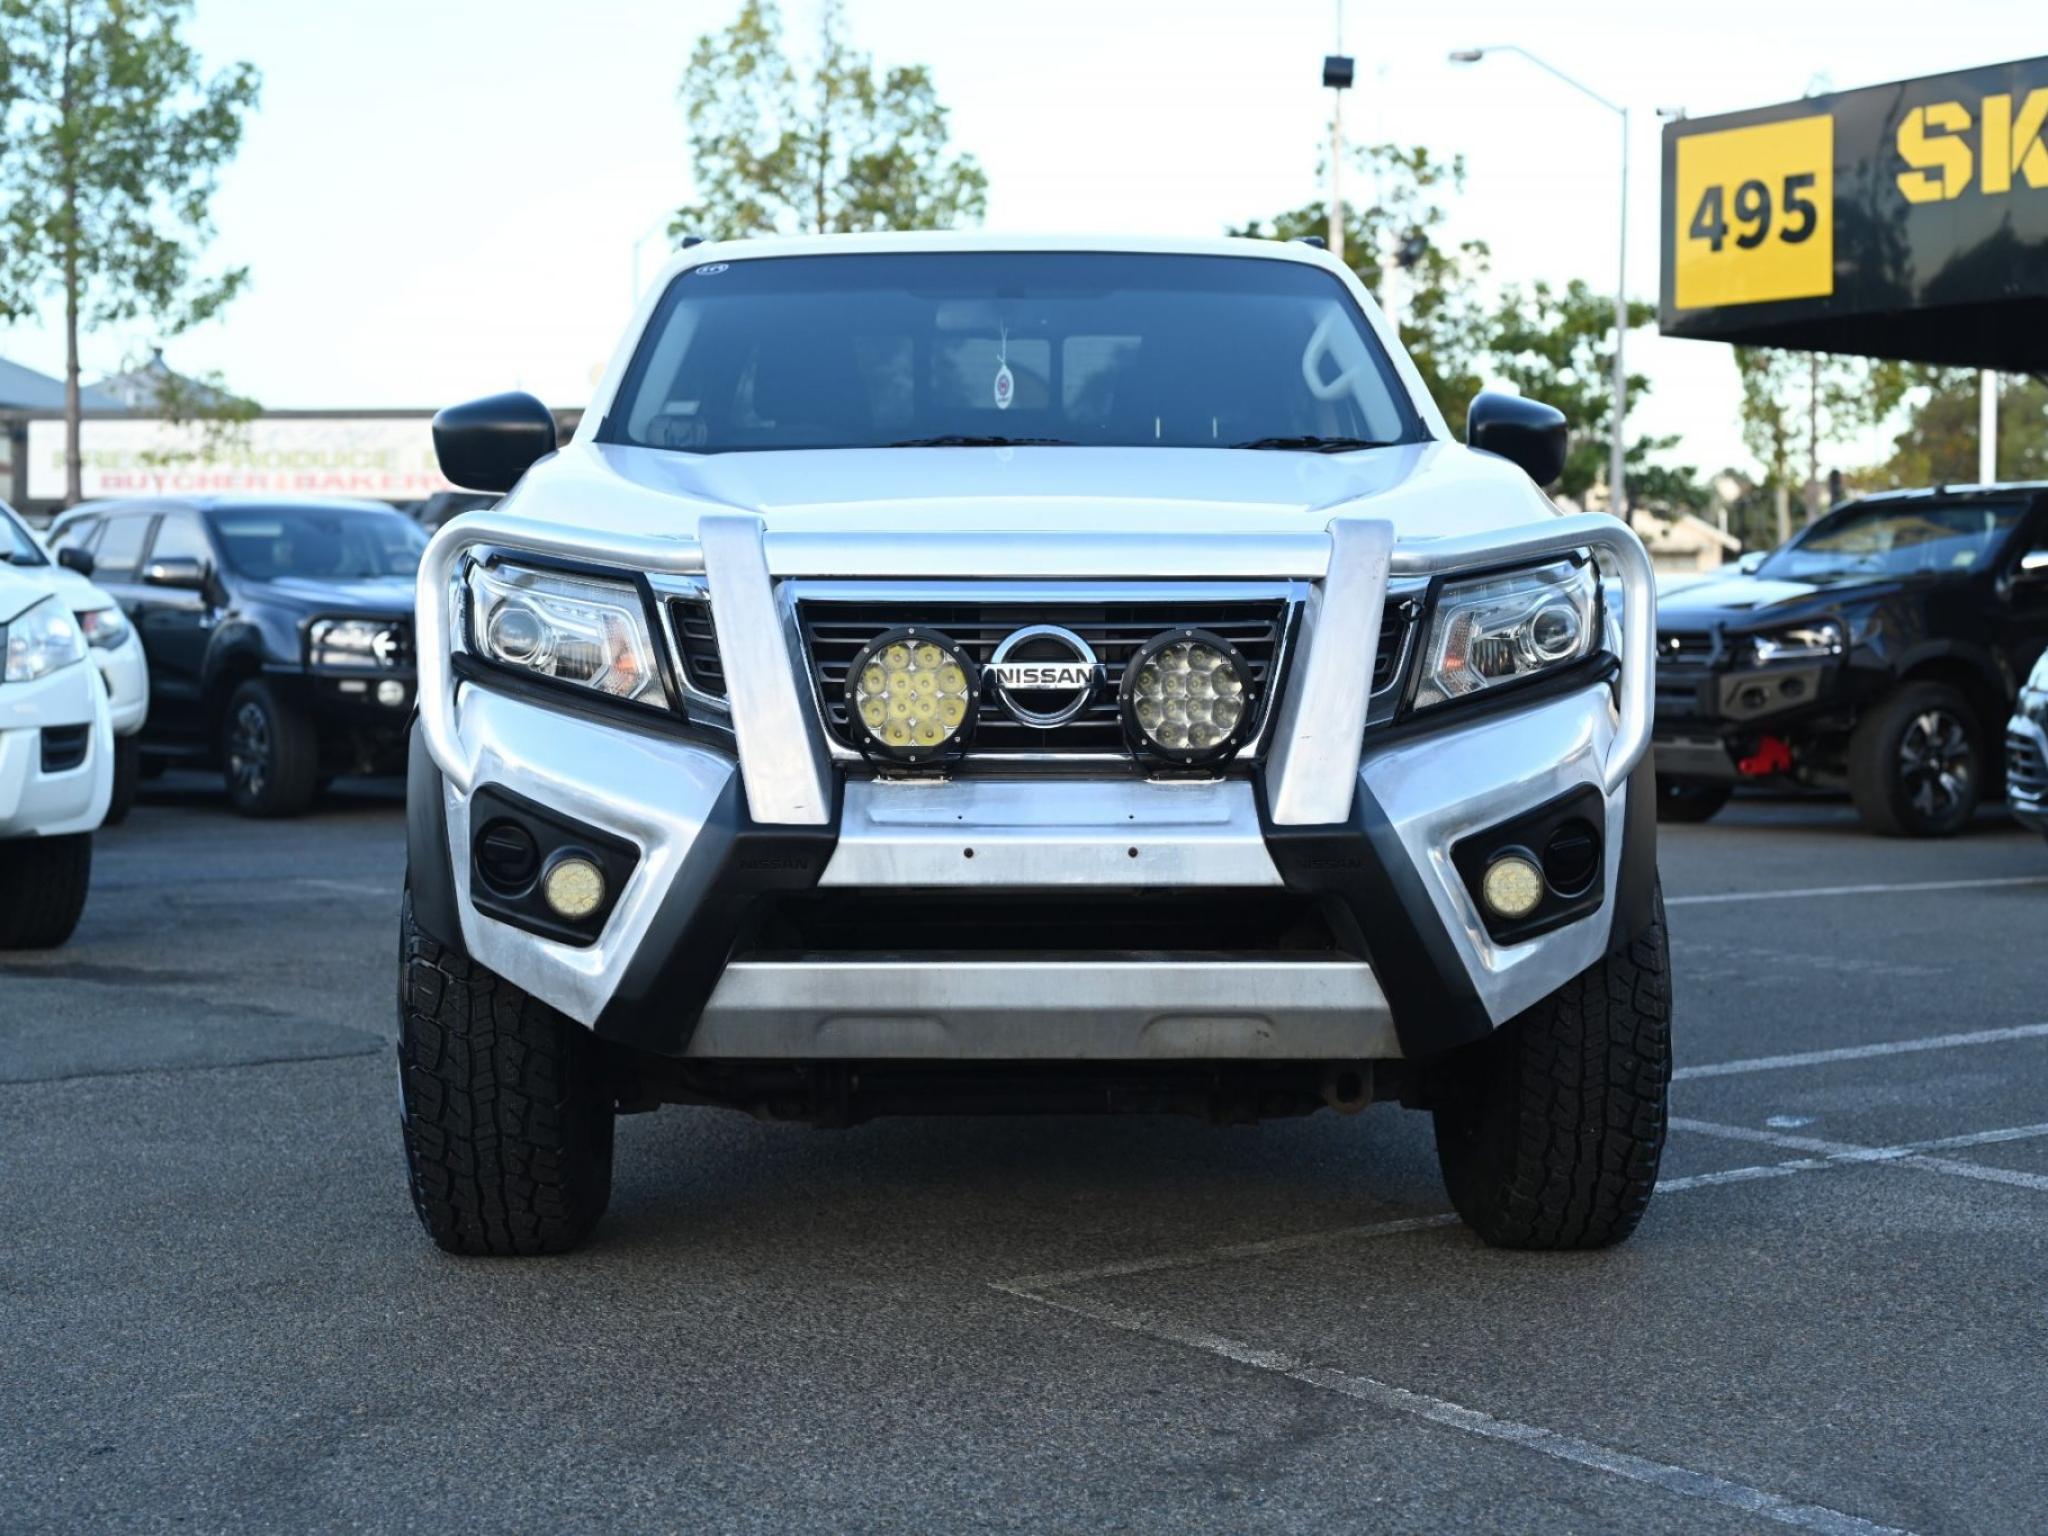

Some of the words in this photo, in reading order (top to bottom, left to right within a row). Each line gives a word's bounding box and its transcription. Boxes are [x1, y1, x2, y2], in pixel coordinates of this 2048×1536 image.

[1689, 172, 1818, 252] 495
[100, 473, 268, 491] BUTCHER
[997, 668, 1093, 684] NISSAN
